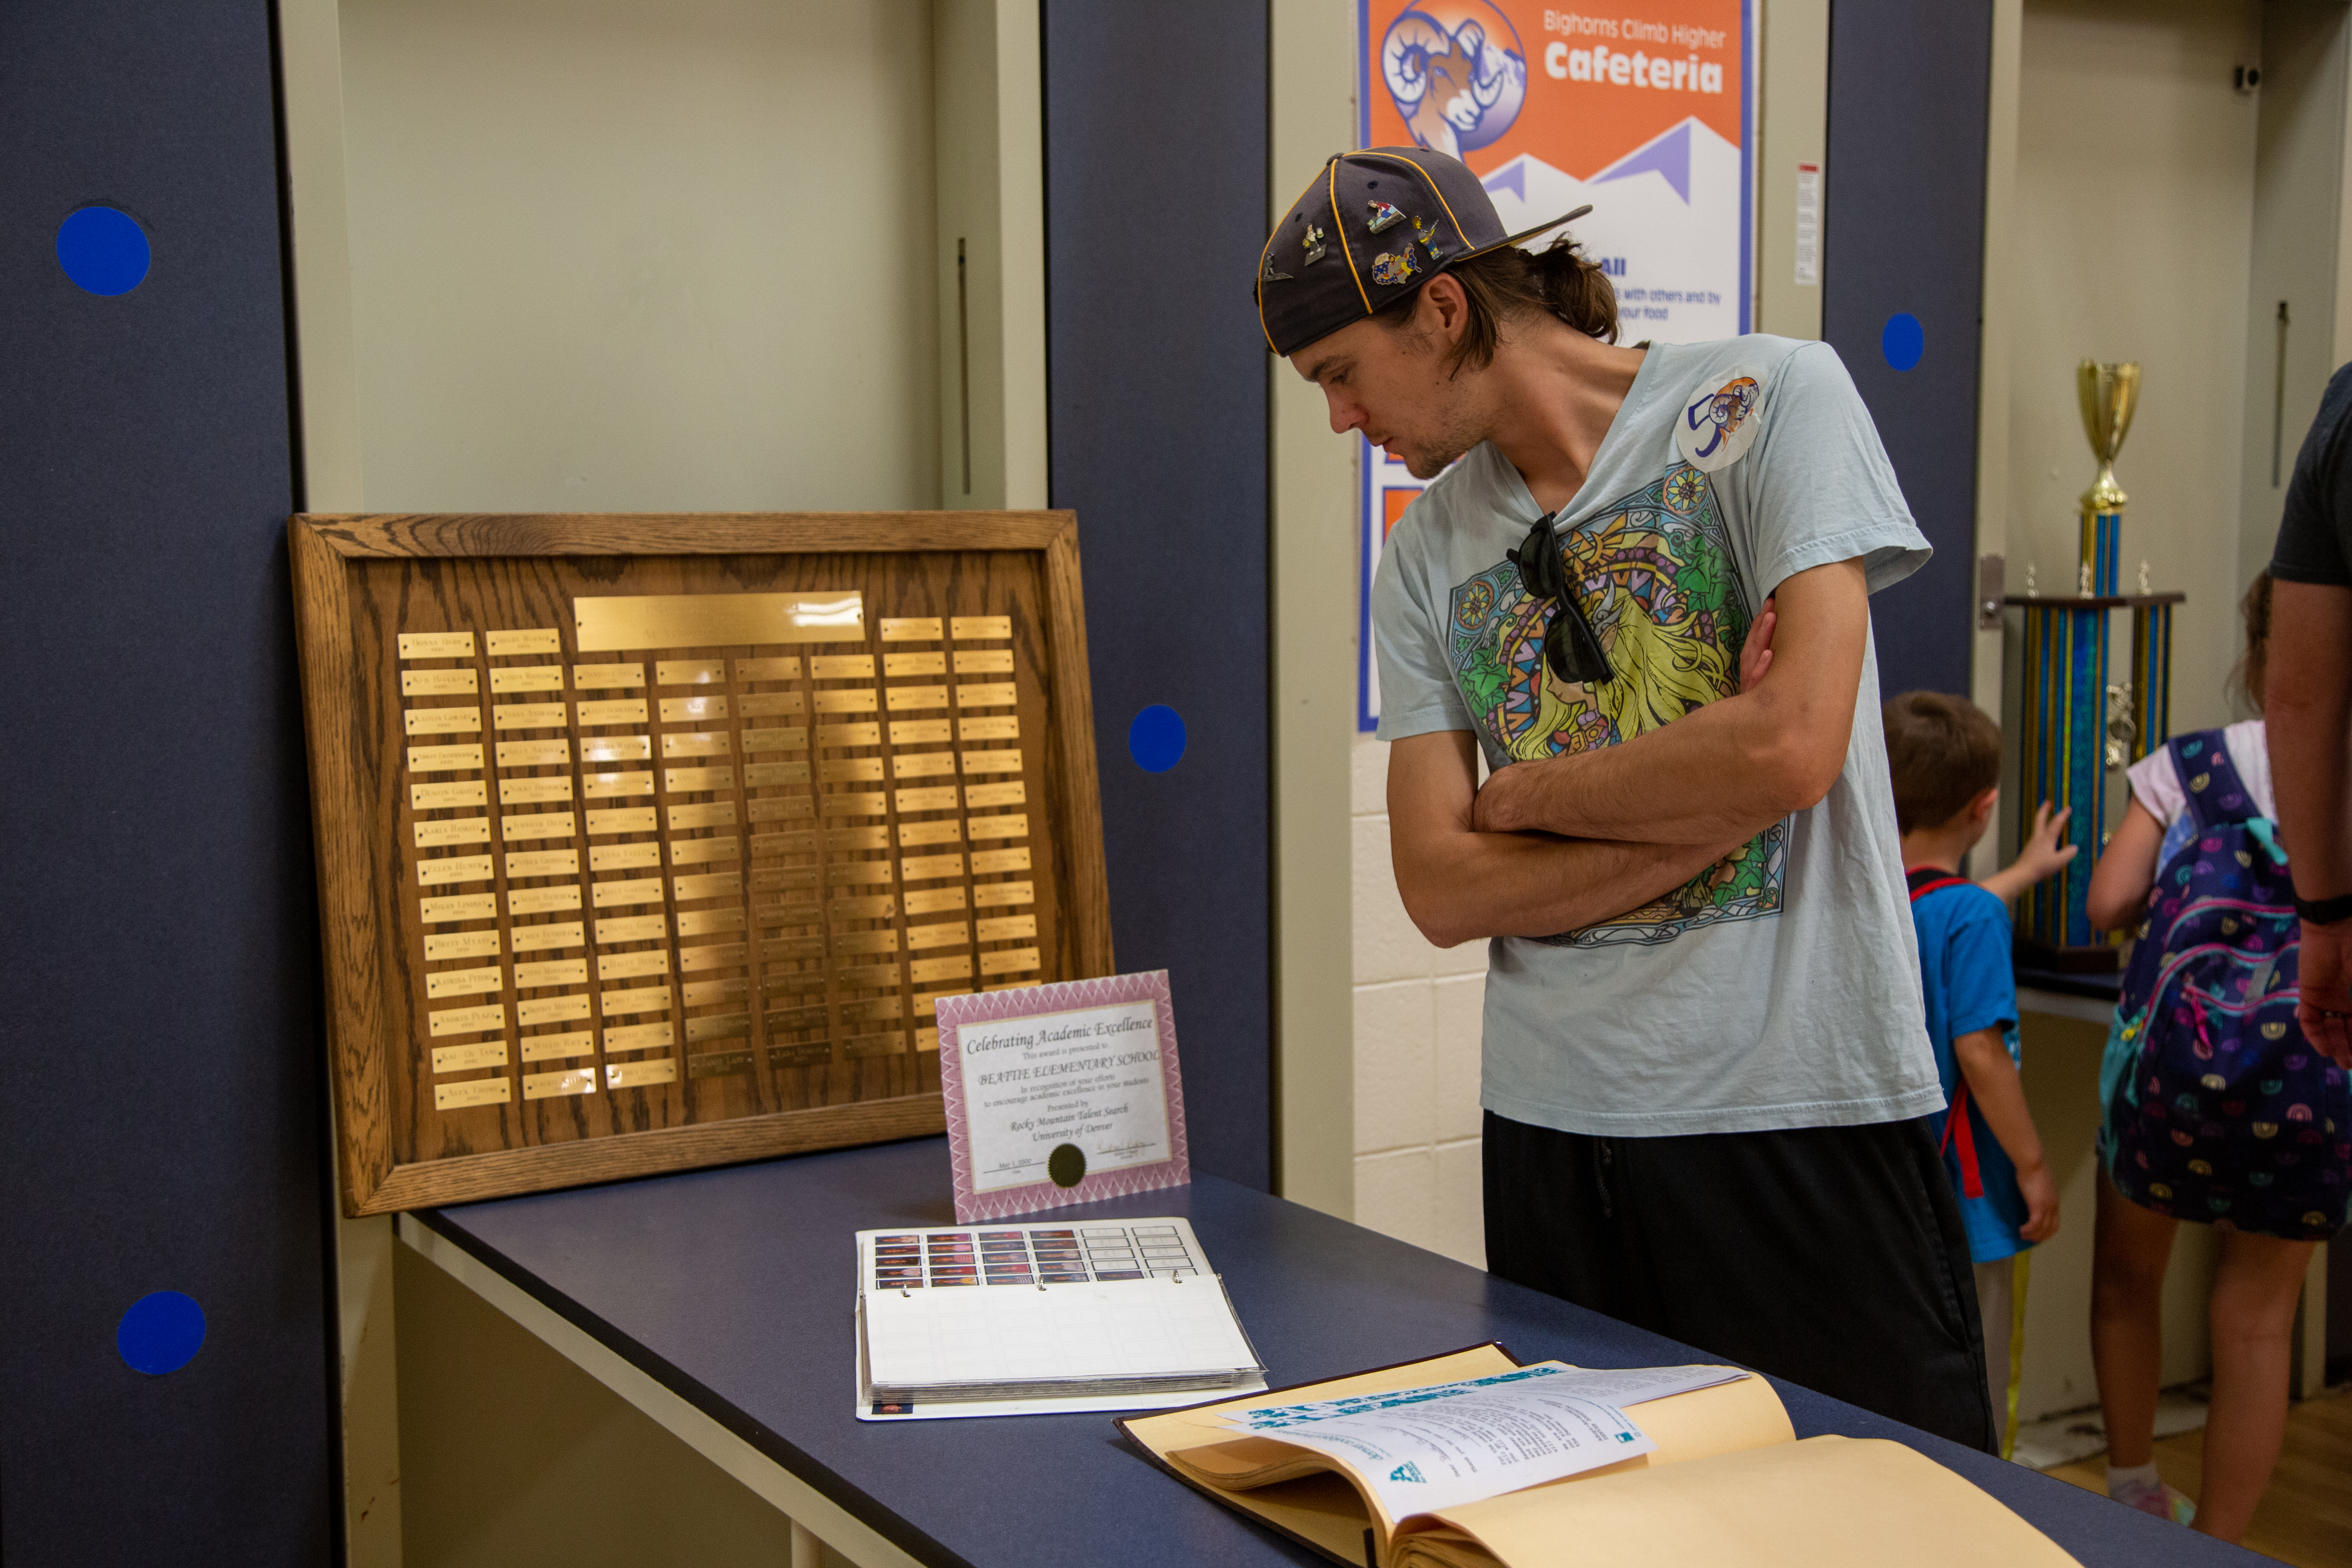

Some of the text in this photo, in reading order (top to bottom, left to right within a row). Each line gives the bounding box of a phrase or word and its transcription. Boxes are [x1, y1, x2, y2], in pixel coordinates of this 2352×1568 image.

[1544, 9, 1726, 50] Bighorns Climb Higher
[1545, 41, 1723, 94] Cafeteria
[1624, 289, 1646, 301] with
[1650, 290, 1683, 303] others
[1686, 291, 1705, 303] and
[1708, 292, 1721, 305] by
[1644, 307, 1668, 320] food
[967, 1017, 1153, 1054] Celebrating Academic Excellence
[1023, 1052, 1037, 1060] This
[1039, 1048, 1060, 1058] award
[1069, 1043, 1101, 1055] presented
[978, 1050, 1160, 1085] BEATTIE ELEMENTARY SCHOOL
[1030, 1081, 1068, 1093] recognition
[1095, 1074, 1115, 1083] efforts
[993, 1095, 1027, 1107] encourage
[1030, 1091, 1060, 1101] academic
[1062, 1085, 1096, 1096] excellence
[1106, 1082, 1121, 1091] your
[1123, 1077, 1149, 1087] students
[1047, 1101, 1079, 1112] Presented
[1010, 1103, 1129, 1131] Rocky Mountain Talent Search
[1032, 1122, 1113, 1141] University of Denver
[1530, 1424, 1546, 1438] notify
[1546, 1420, 1566, 1437] sincere
[1554, 1420, 1571, 1435] Denver
[1563, 1408, 1604, 1441] Adopt-An-Animal
[1591, 1423, 1608, 1440] DENVER
[1515, 1430, 1532, 1445] become
[1517, 1438, 1526, 1446] are
[1531, 1432, 1552, 1453] transfer
[1552, 1432, 1562, 1441] are
[1565, 1439, 1575, 1448] our
[1570, 1438, 1580, 1446] the
[1487, 1444, 1497, 1453] the
[1497, 1439, 1509, 1450] will
[1508, 1437, 1530, 1459] Remember
[1532, 1448, 1541, 1456] may
[1546, 1440, 1558, 1452] will
[1496, 1455, 1507, 1465] for
[1499, 1451, 1512, 1464] will
[1508, 1452, 1519, 1462] you
[1526, 1449, 1536, 1458] and
[1448, 1463, 1461, 1477] Dear
[1463, 1457, 1478, 1472] Thank
